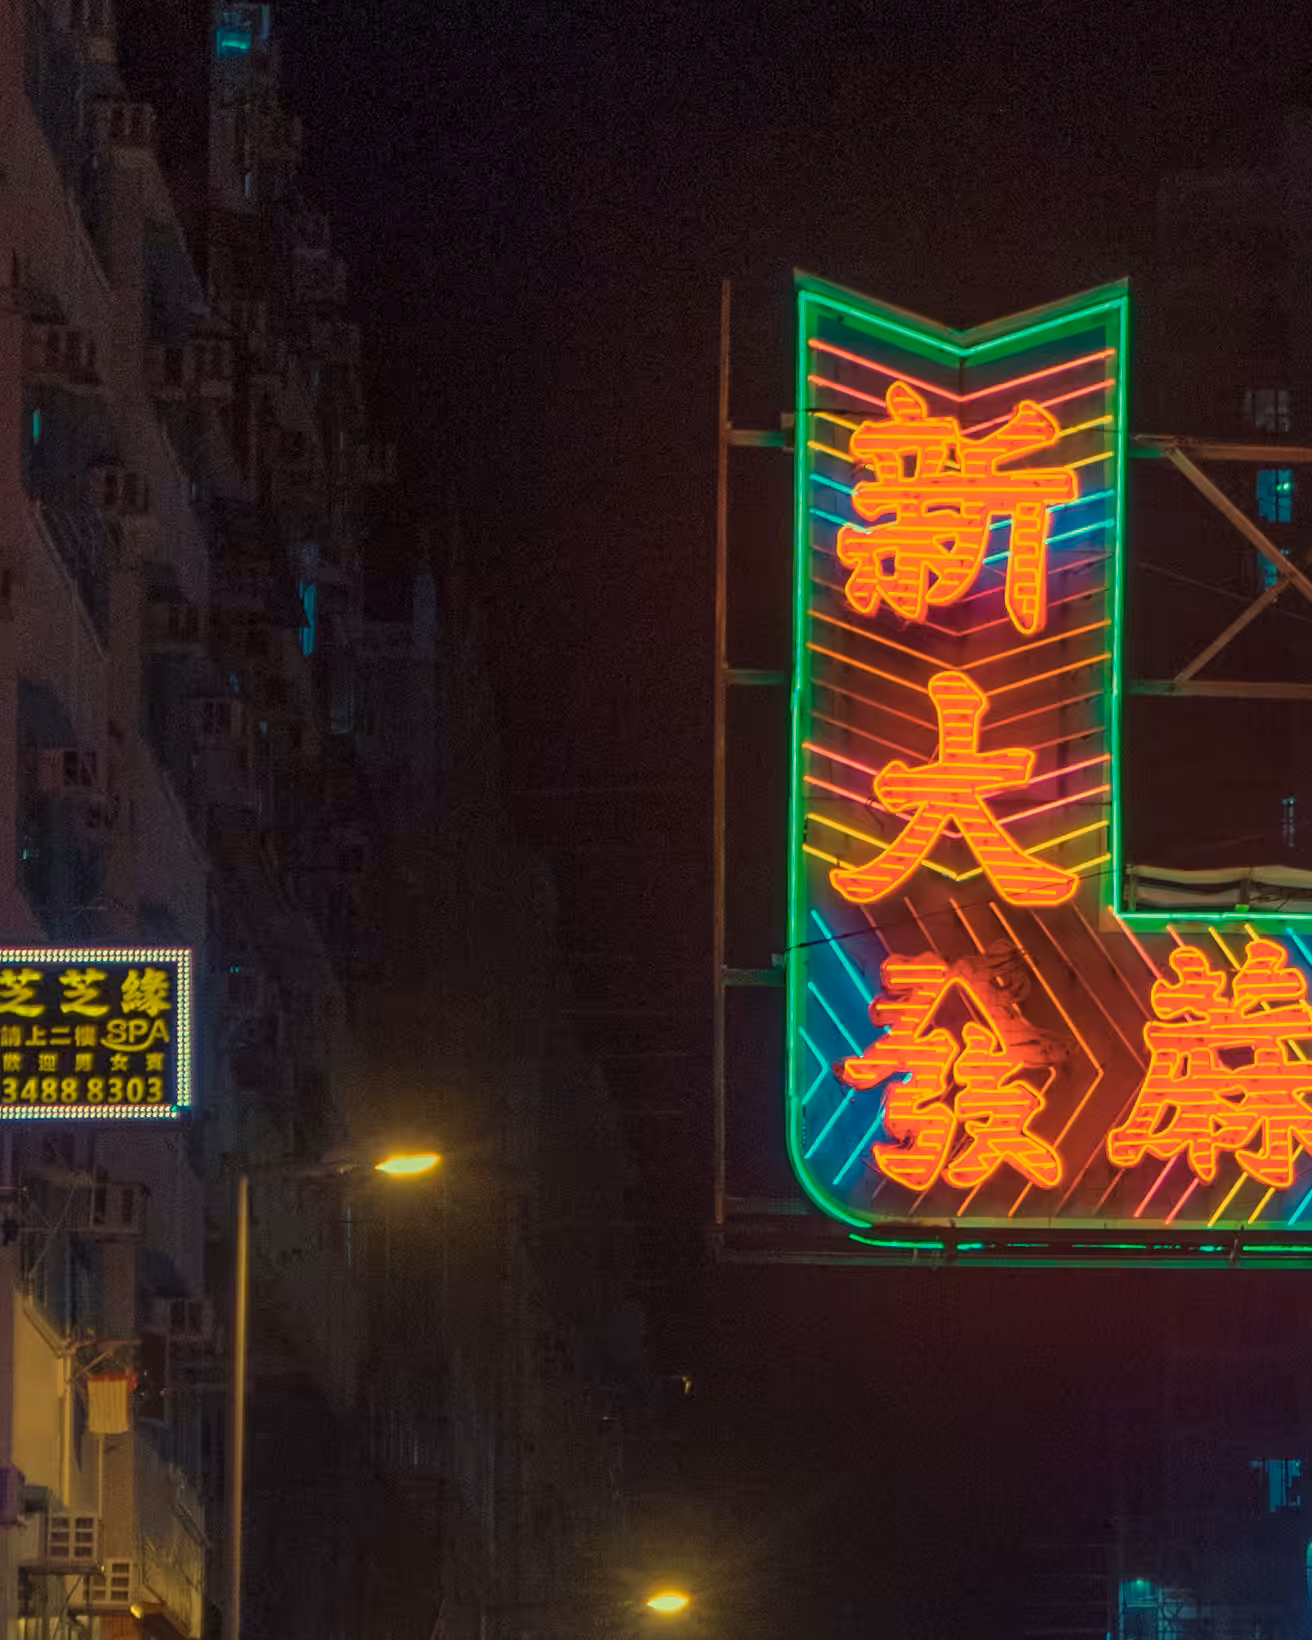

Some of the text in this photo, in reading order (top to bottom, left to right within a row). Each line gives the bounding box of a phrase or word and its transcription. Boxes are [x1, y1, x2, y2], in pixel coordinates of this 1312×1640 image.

[104, 1018, 170, 1051] SPA
[2, 1077, 163, 1103] 3488 8303
